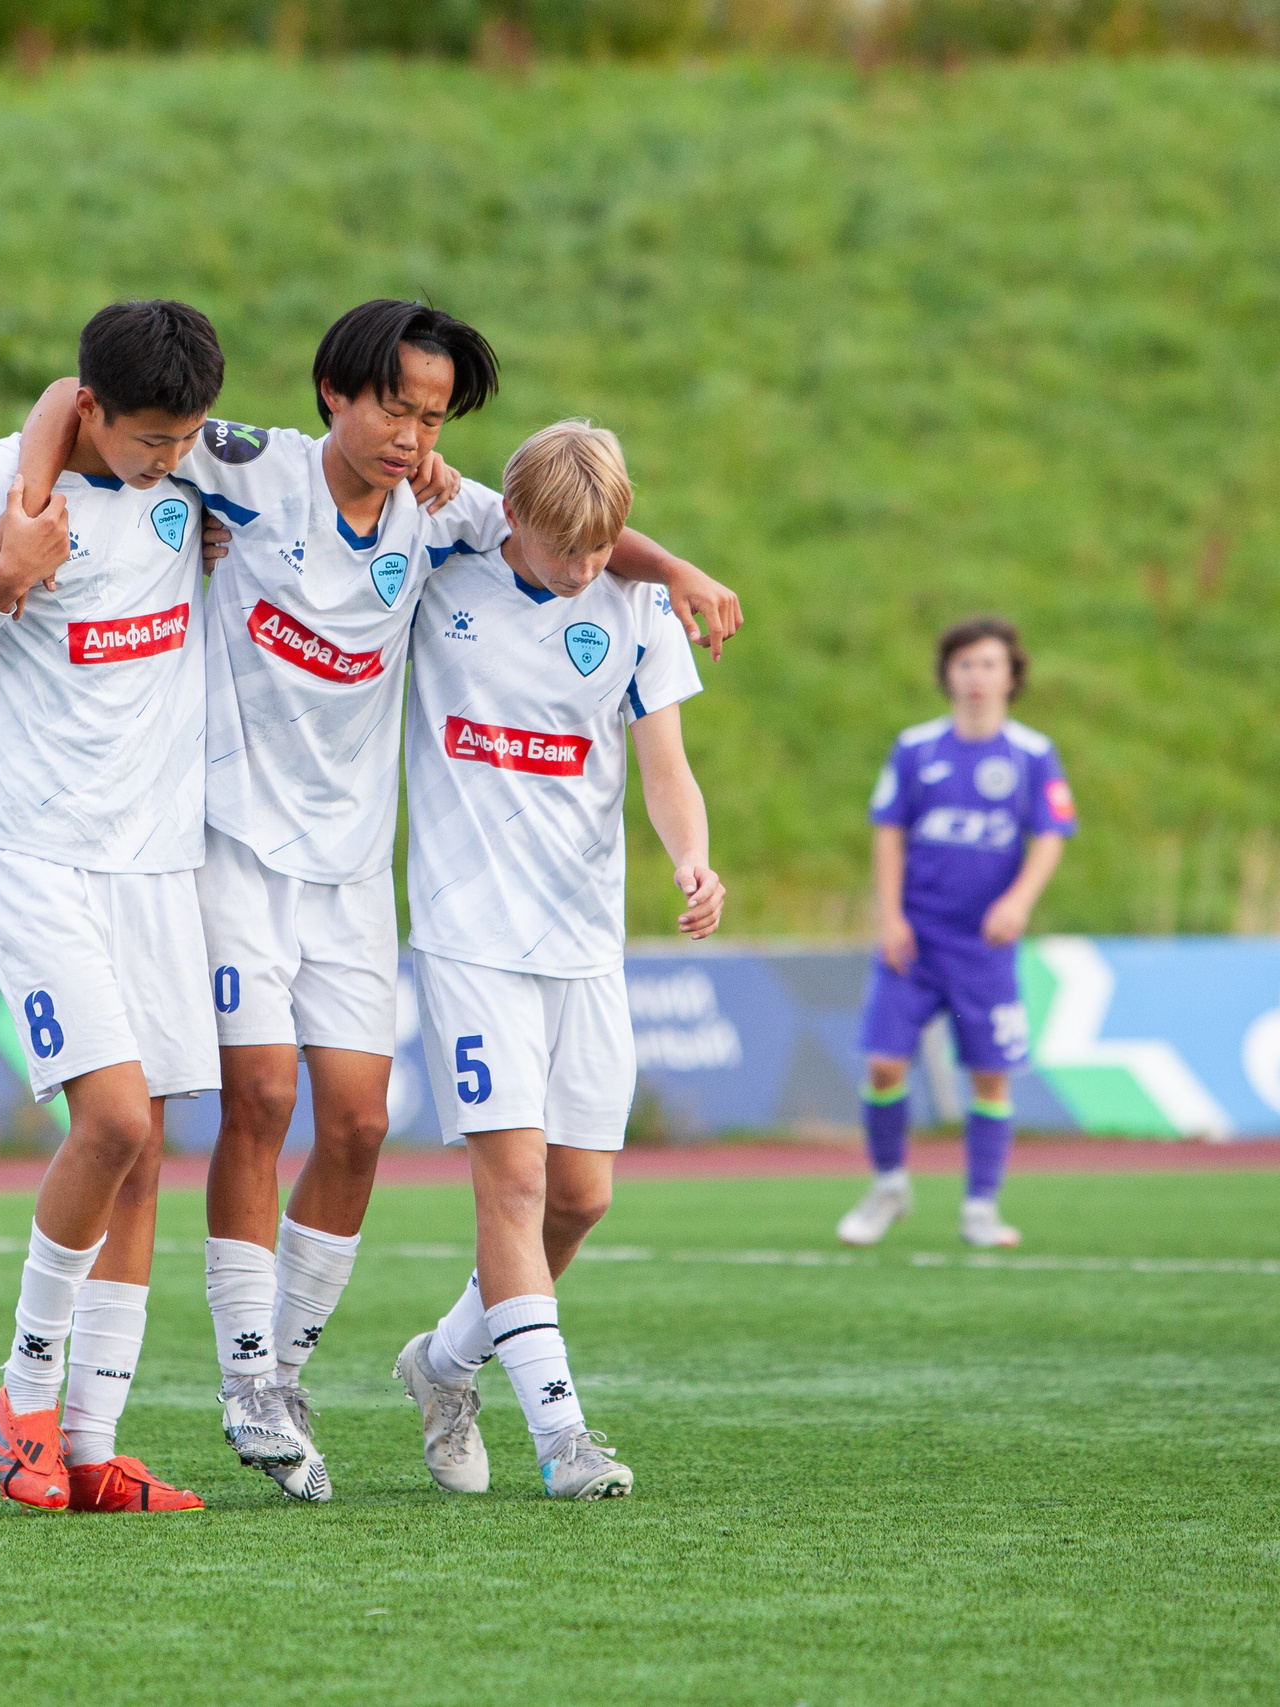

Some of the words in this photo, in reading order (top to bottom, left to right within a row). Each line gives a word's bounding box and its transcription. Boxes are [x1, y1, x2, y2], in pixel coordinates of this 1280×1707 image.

[67, 549, 90, 561] LME
[279, 549, 305, 576] KELME
[83, 623, 151, 651] Альфа
[152, 616, 186, 641] Банк
[259, 614, 333, 665] Альфа
[333, 655, 376, 676] Бан
[444, 631, 478, 641] KELME
[456, 724, 523, 759] Альфа
[527, 737, 578, 762] Банк
[24, 989, 64, 1059] 8
[456, 1035, 492, 1105] 5
[19, 1345, 52, 1361] KELME
[232, 1349, 268, 1360] KELME
